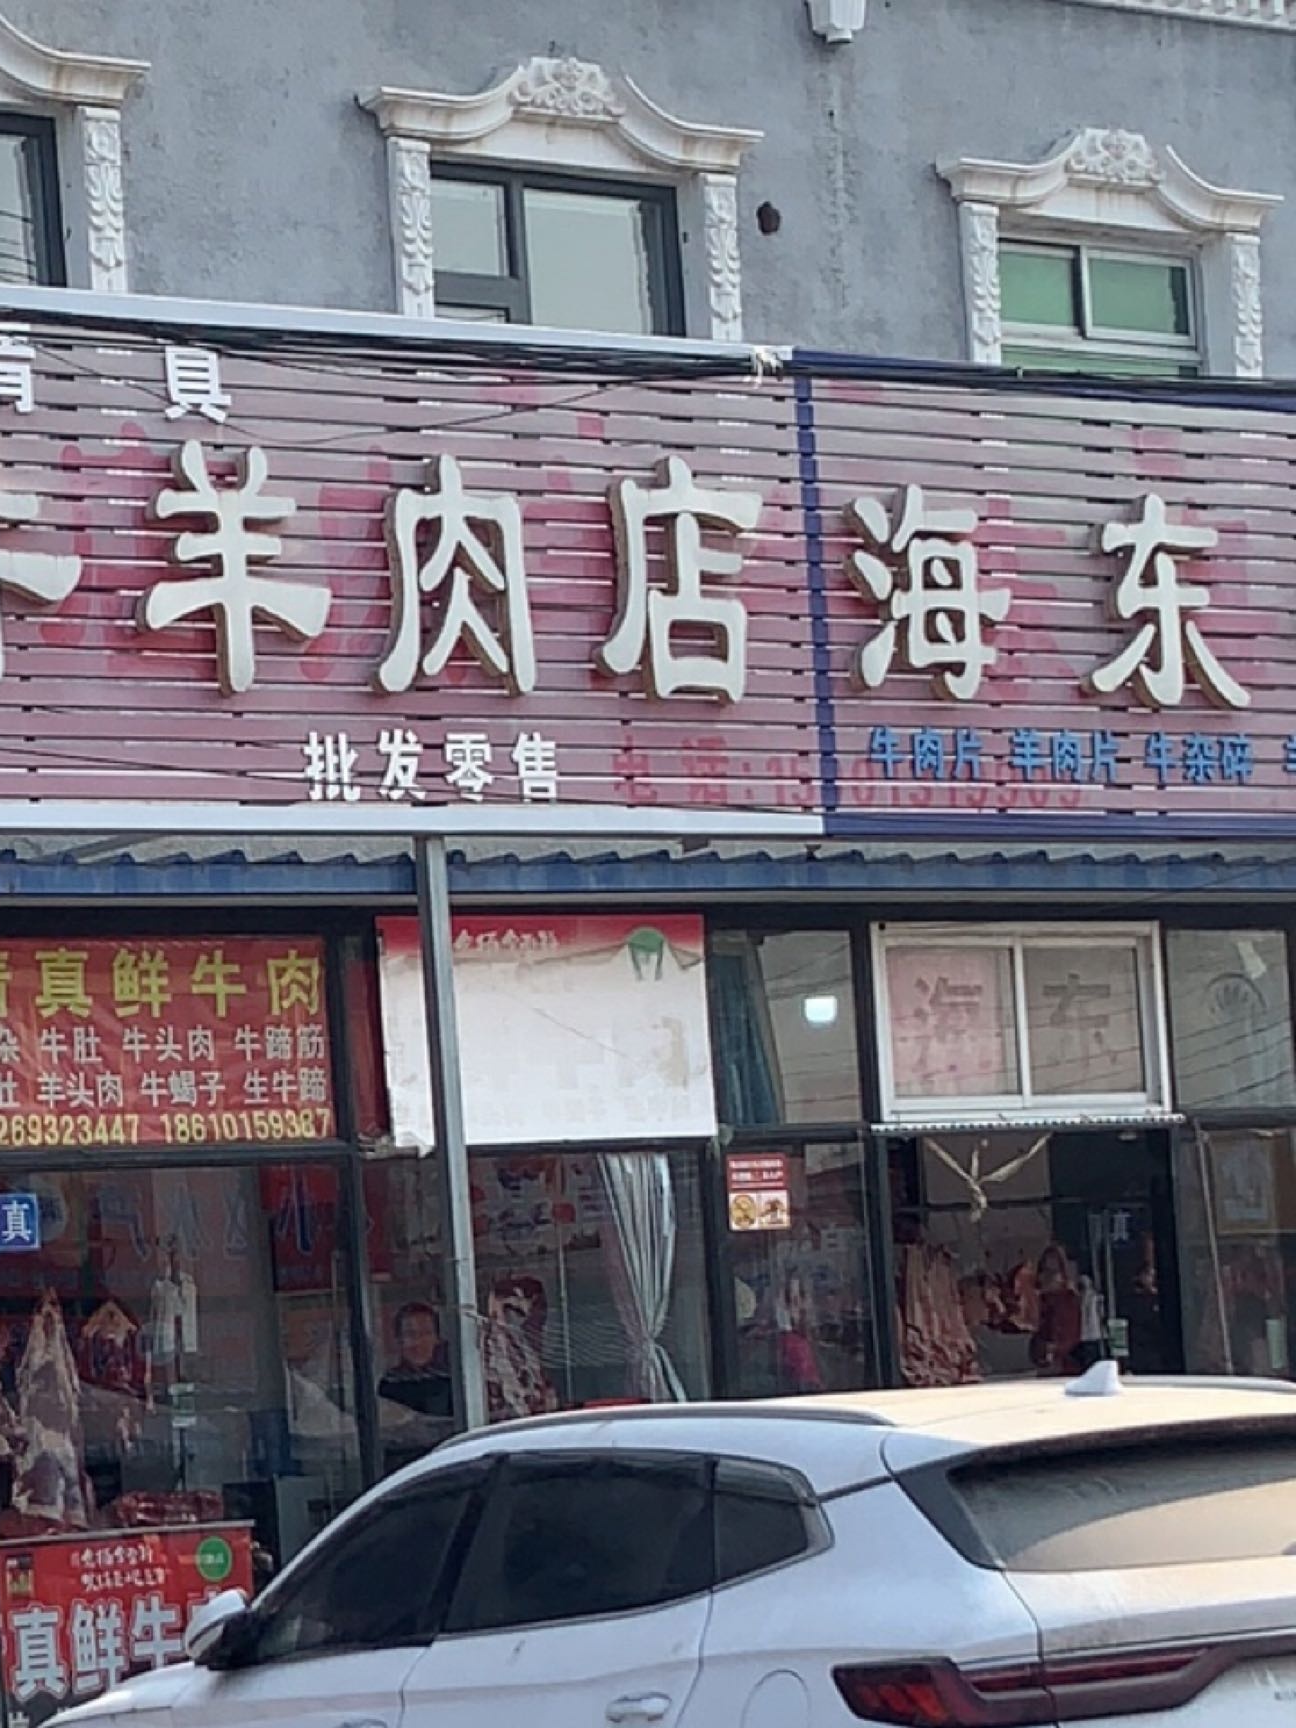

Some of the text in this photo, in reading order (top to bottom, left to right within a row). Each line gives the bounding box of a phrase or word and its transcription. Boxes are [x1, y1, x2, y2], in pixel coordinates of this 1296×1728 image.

[842, 484, 1253, 709] 海东
[303, 729, 561, 802] 批发零售
[869, 726, 984, 779] 牛肉片
[1008, 726, 1120, 782] 羊肉片
[1144, 732, 1256, 785] 牛杂碎
[39, 1026, 103, 1064] 牛肚
[123, 1025, 216, 1063] 牛头肉
[235, 1024, 326, 1061] 牛蹄筋
[37, 1072, 124, 1109] 羊头肉
[244, 1066, 327, 1106] 生牛蹄
